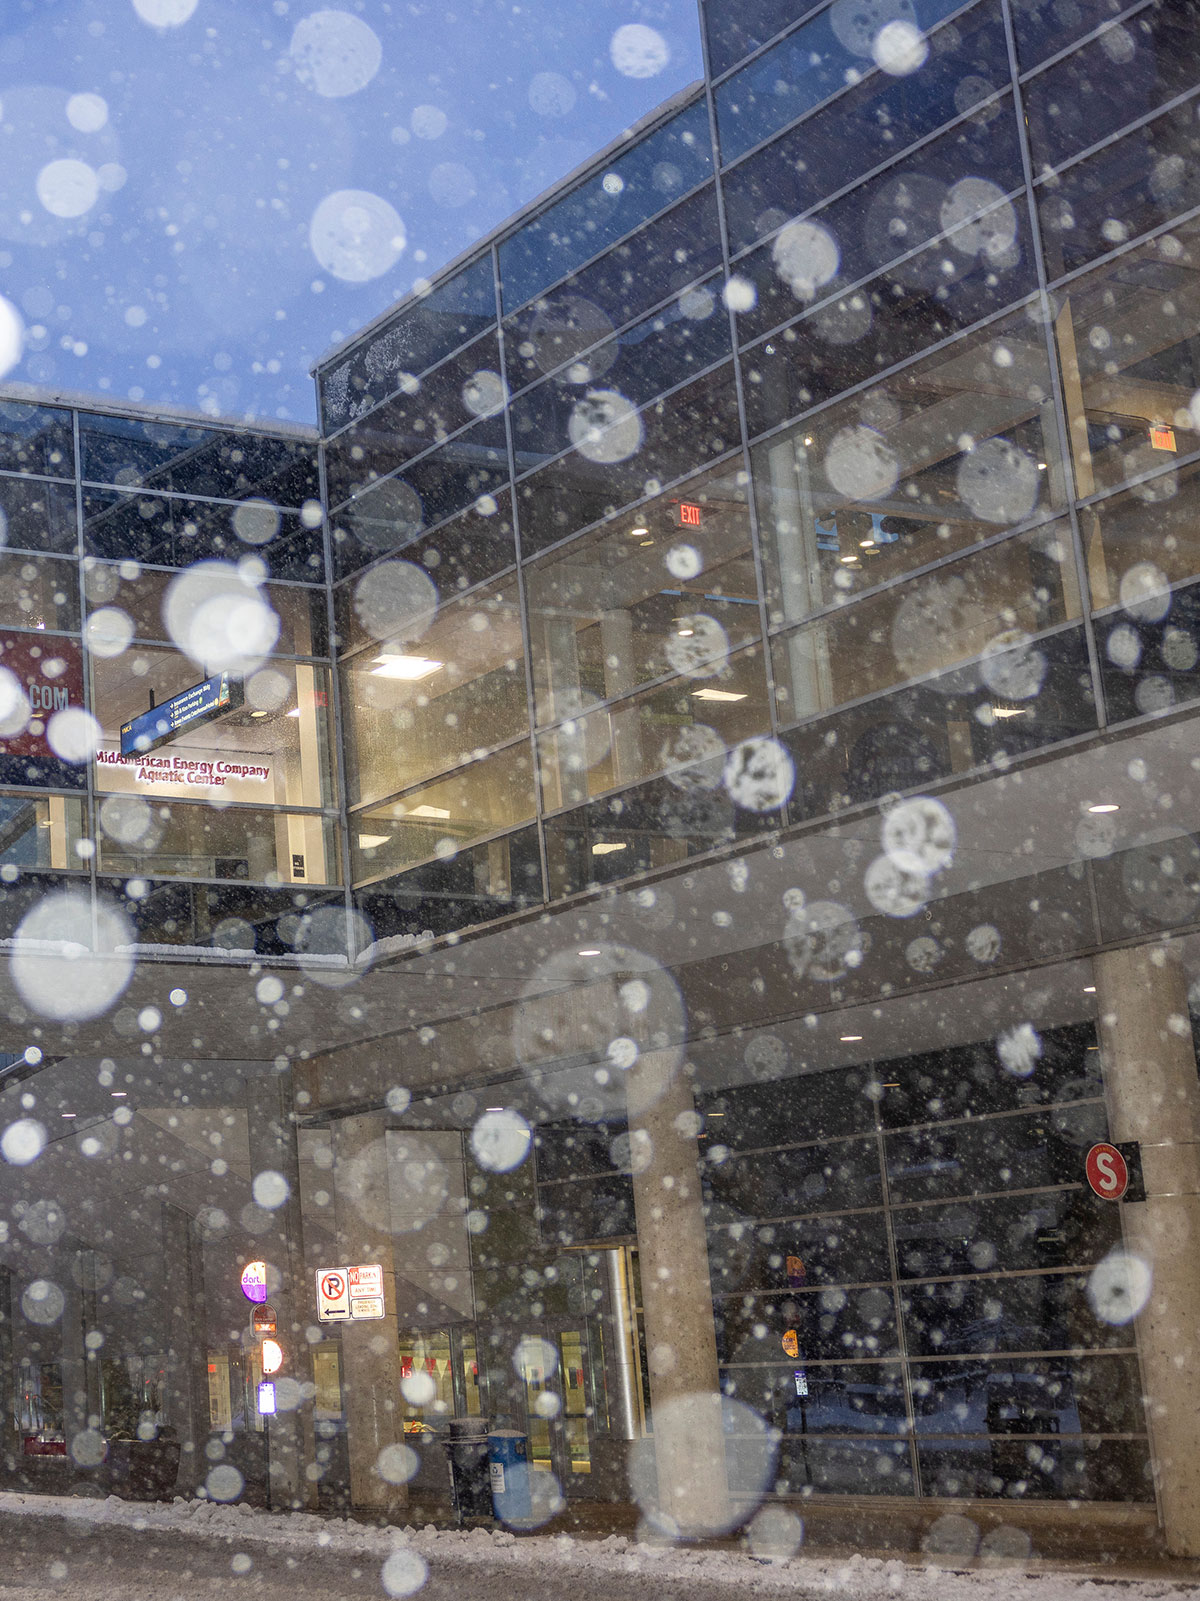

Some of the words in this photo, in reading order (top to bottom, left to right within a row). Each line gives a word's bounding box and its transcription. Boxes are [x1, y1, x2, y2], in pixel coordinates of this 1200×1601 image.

[680, 504, 701, 525] EXIT
[138, 767, 185, 783] Aquatic
[186, 771, 227, 786] Center
[173, 757, 214, 775] Energy
[216, 761, 270, 780] Company
[1096, 1152, 1118, 1190] S
[350, 1271, 360, 1284] NO
